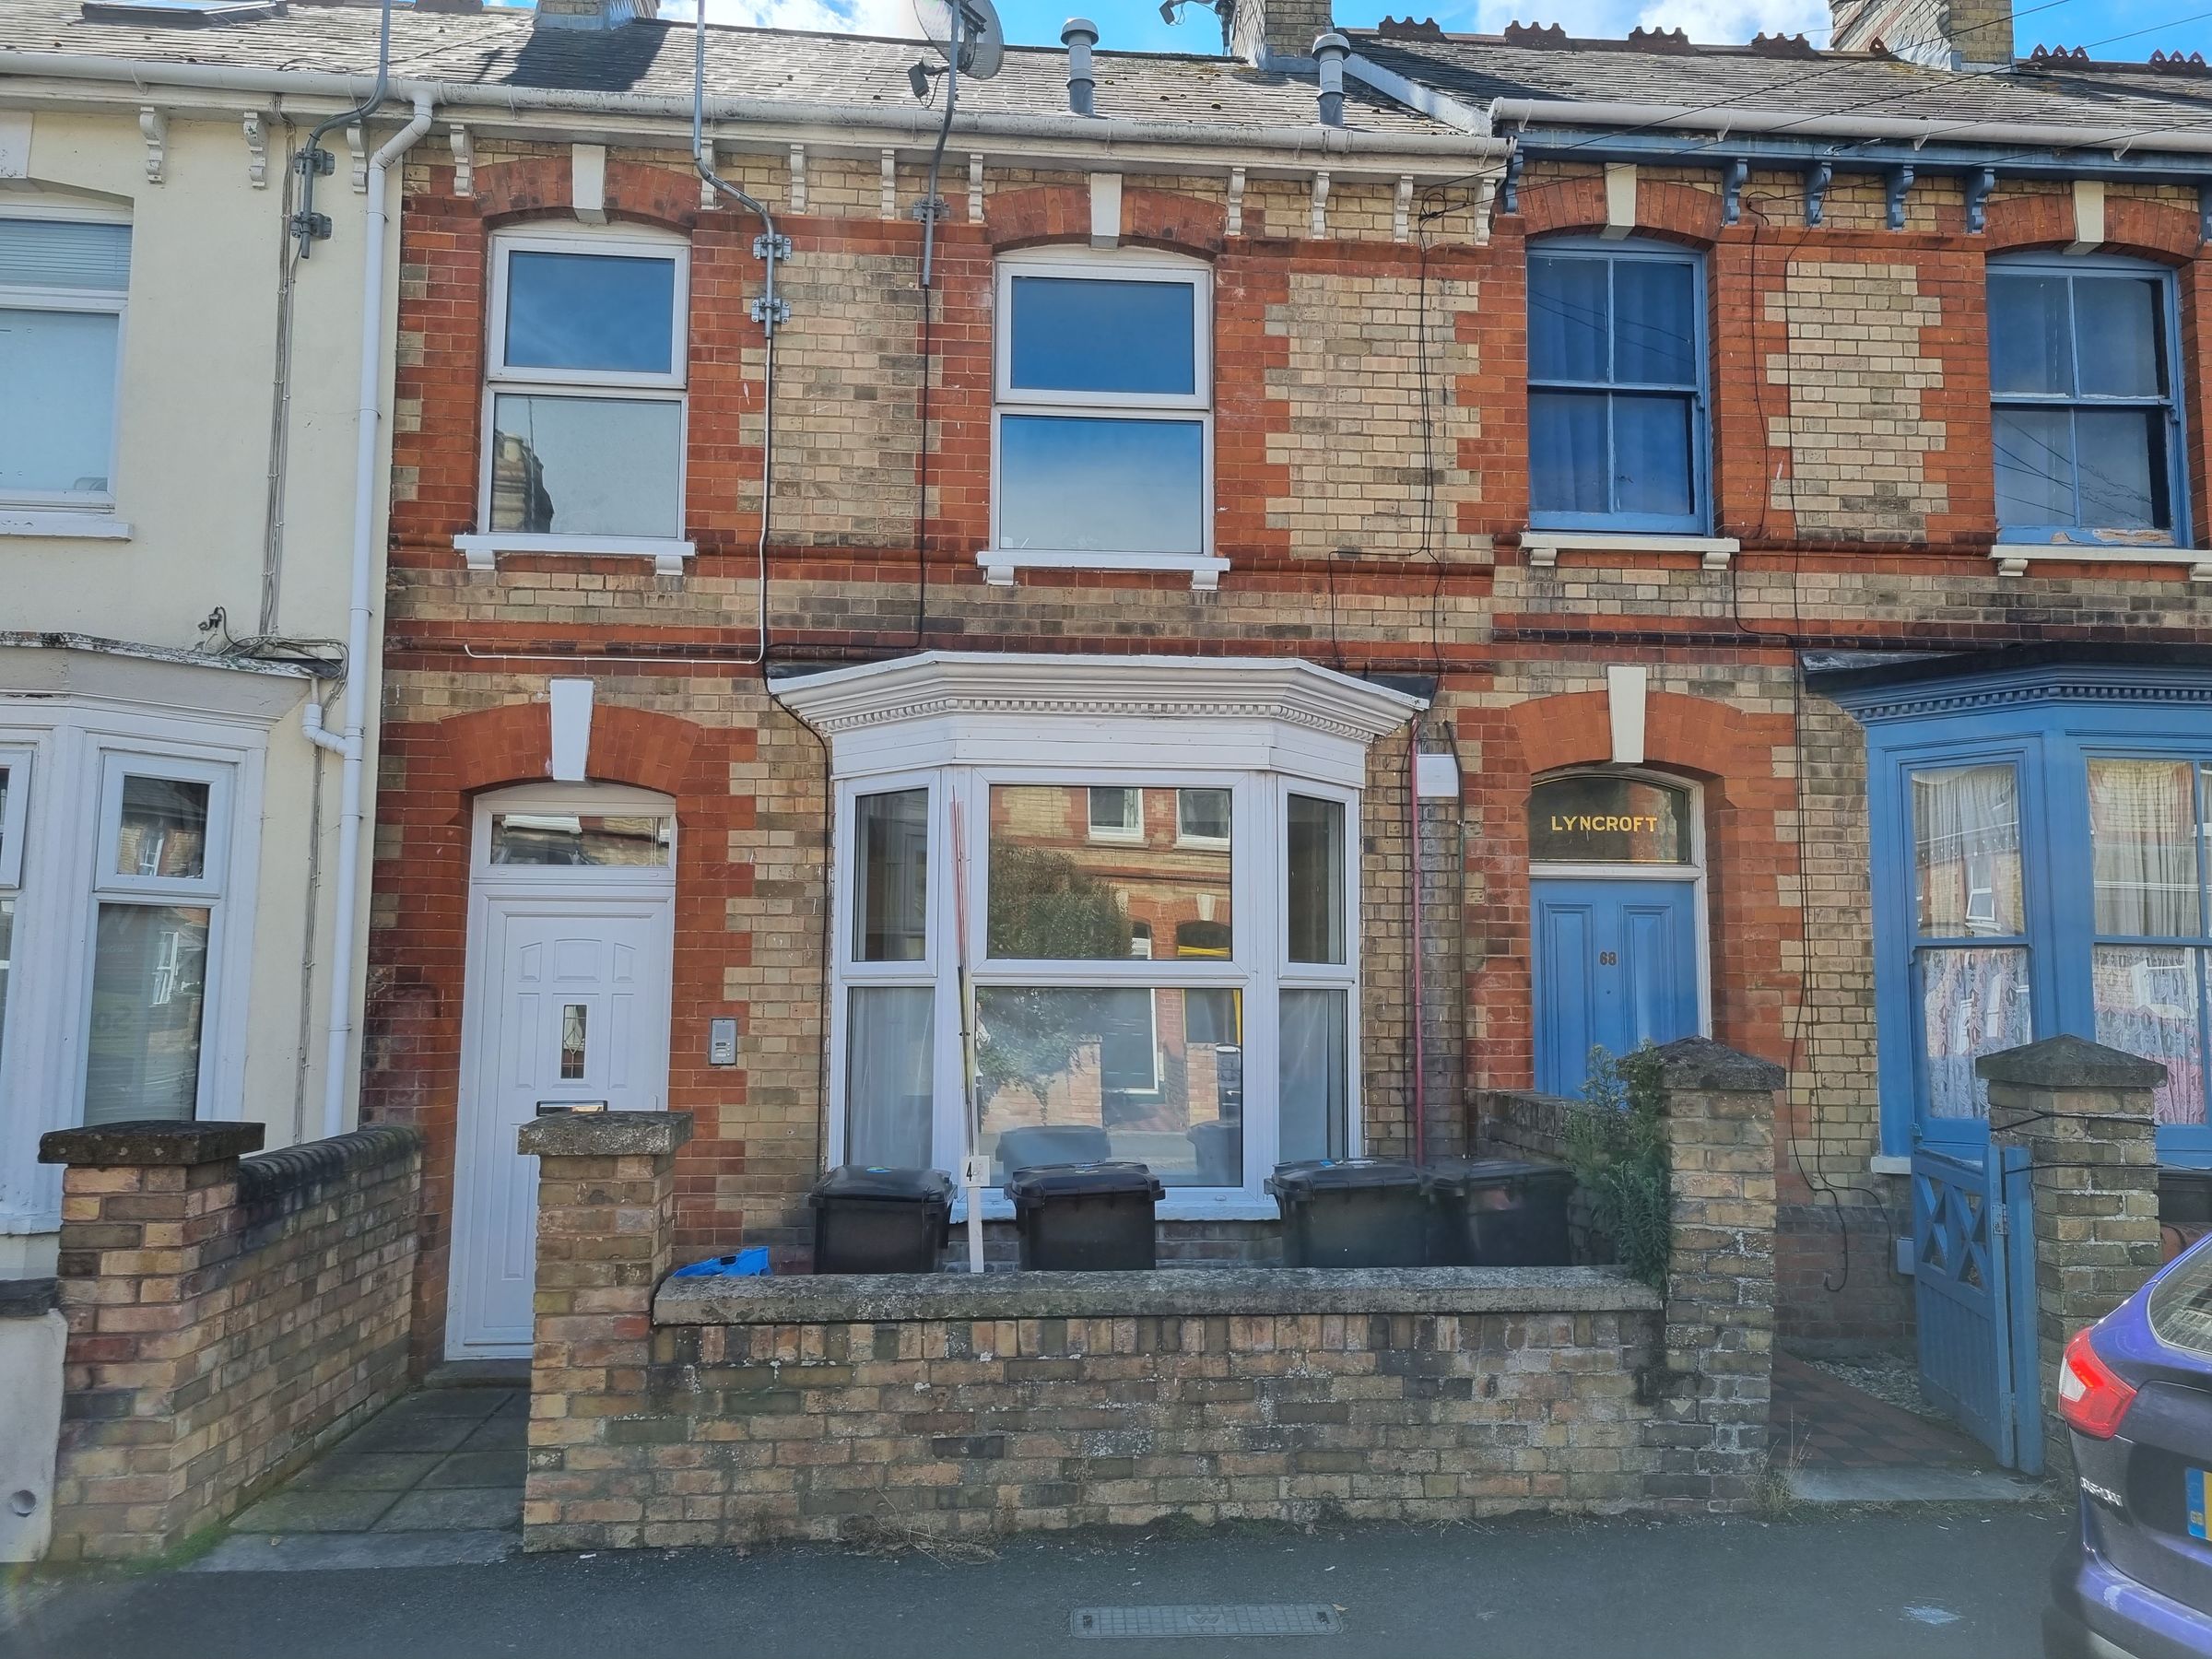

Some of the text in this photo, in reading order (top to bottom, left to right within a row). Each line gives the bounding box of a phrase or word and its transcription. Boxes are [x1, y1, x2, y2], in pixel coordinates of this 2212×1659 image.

[1551, 816, 1658, 832] LYNCROFT
[1599, 951, 1618, 966] 68
[966, 1161, 973, 1182] 4
